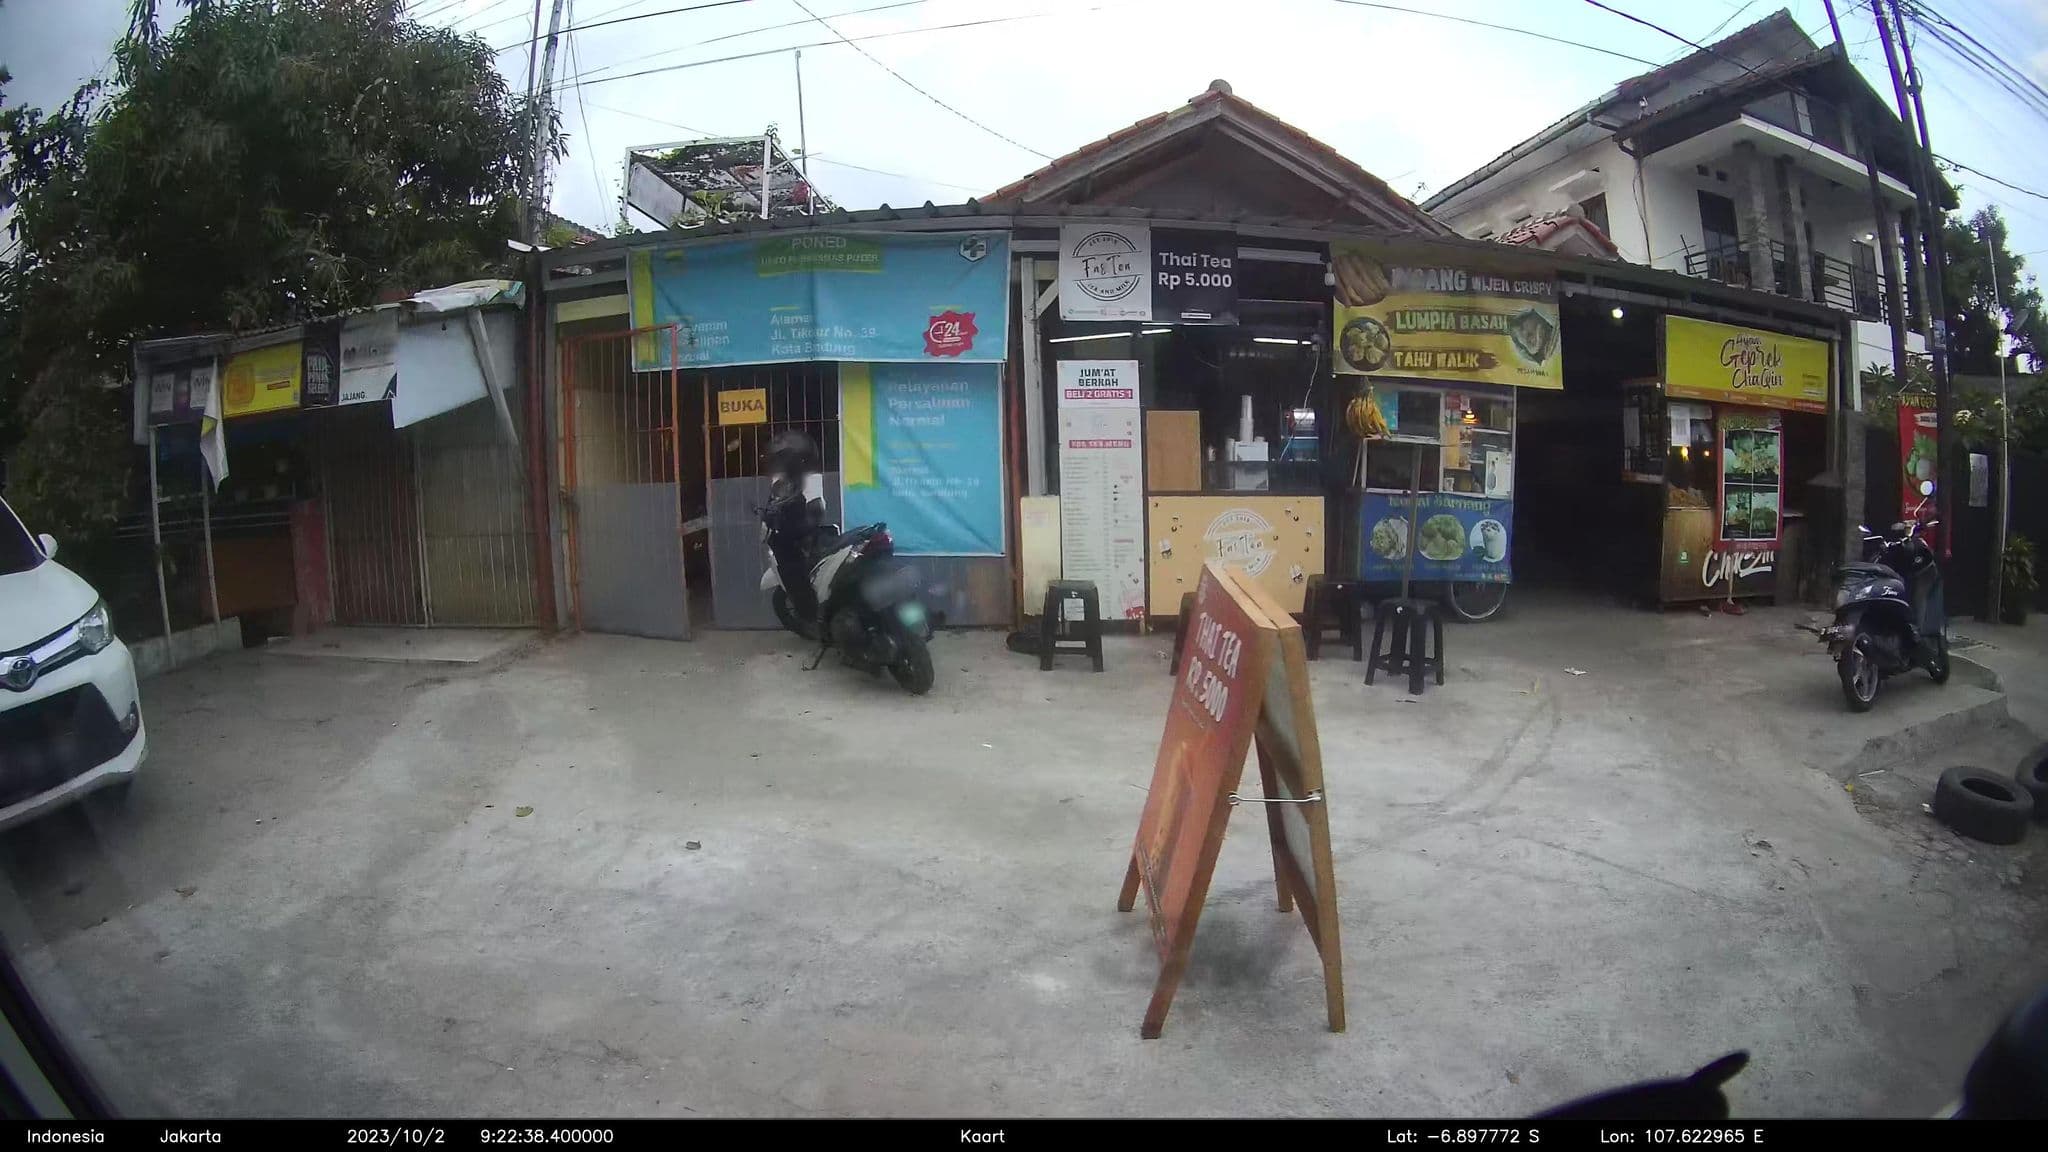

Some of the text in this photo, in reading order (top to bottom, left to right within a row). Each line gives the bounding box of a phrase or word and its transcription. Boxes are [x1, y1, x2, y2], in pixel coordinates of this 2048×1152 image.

[1159, 252, 1232, 269] Thai Tea
[1158, 272, 1232, 290] Rp 5.000
[1472, 275, 1510, 292] WIJEN
[1513, 280, 1552, 296] CRISPY
[1395, 311, 1508, 330] LUMPIA BASAH
[1394, 350, 1432, 367] TAHU
[1720, 338, 1781, 374] Geprek
[1079, 368, 1116, 378] JUM'AT
[1731, 367, 1783, 390] ChaQin
[1078, 378, 1119, 387] BERKAH
[1066, 390, 1132, 398] BELI 2 GRATIS 1
[719, 399, 765, 414] BUKA
[1218, 630, 1242, 679] TEA
[1200, 670, 1229, 722] 5000
